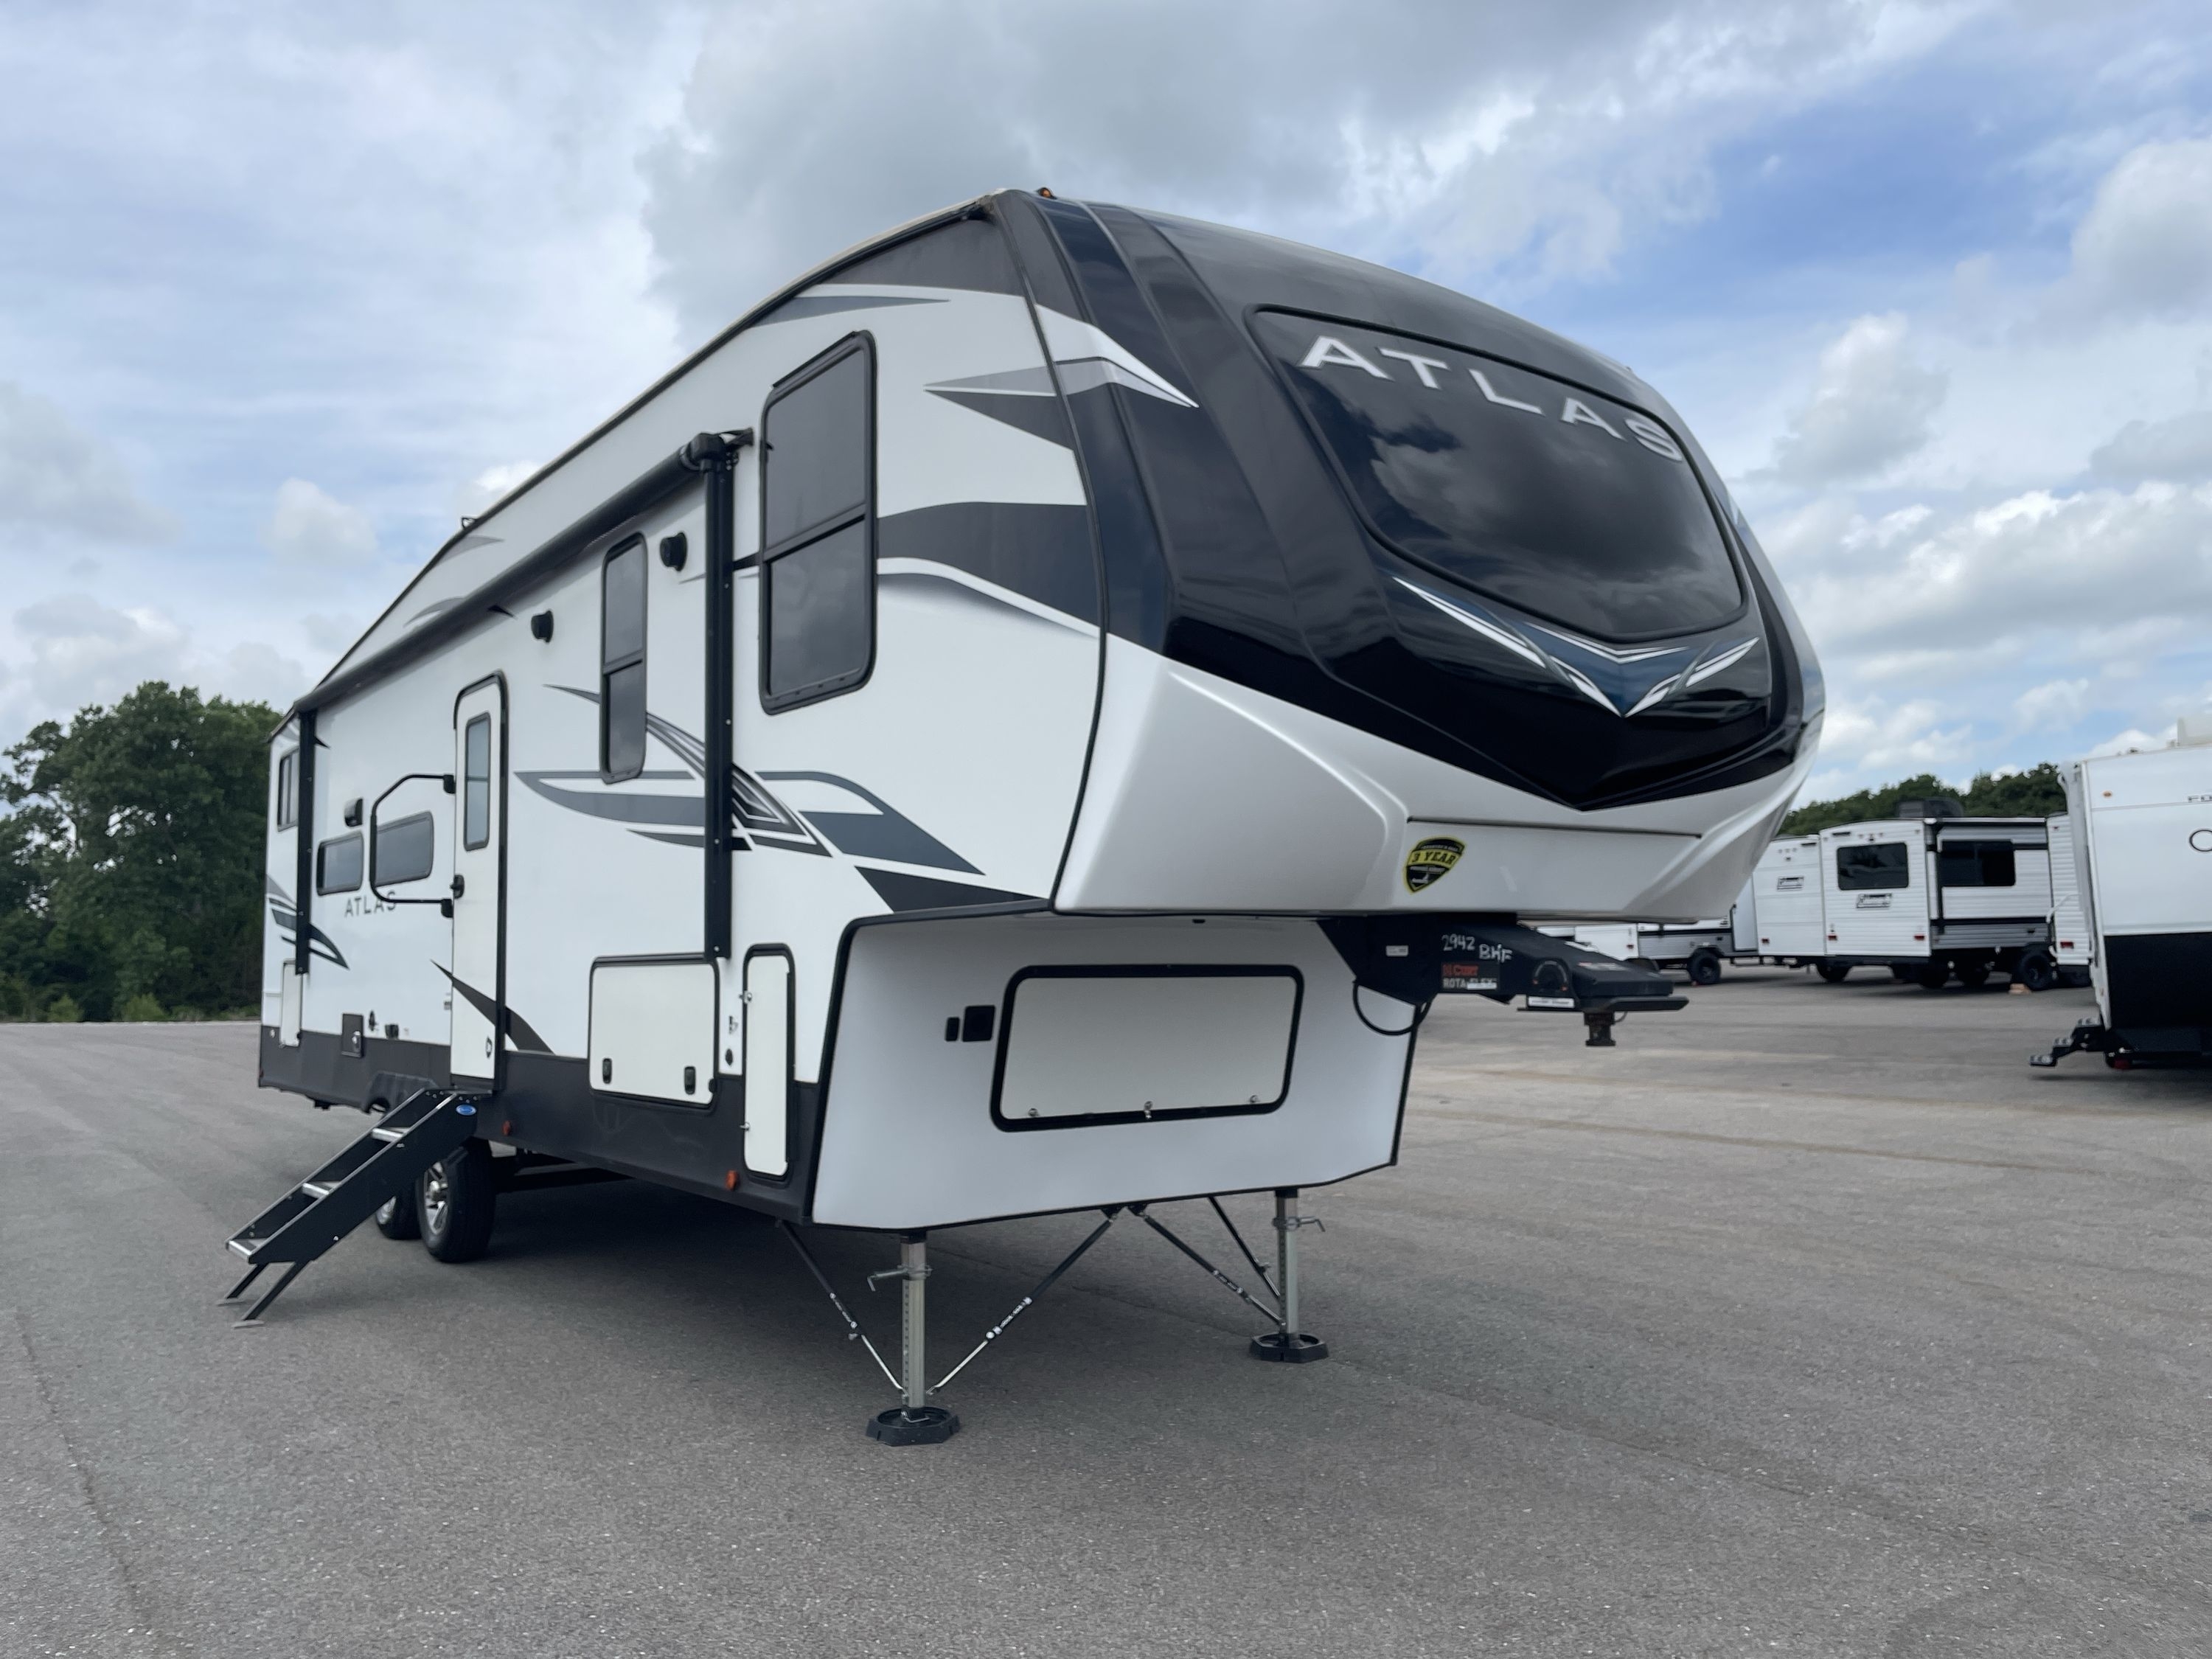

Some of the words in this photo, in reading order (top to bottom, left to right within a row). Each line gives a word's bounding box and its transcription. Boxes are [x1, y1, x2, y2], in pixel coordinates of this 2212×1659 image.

[1295, 335, 1684, 462] ATLAS
[1411, 852, 1421, 863] 3
[1424, 851, 1456, 865] YEAR
[344, 889, 396, 917] ATLAS
[1441, 933, 1475, 951] 2942
